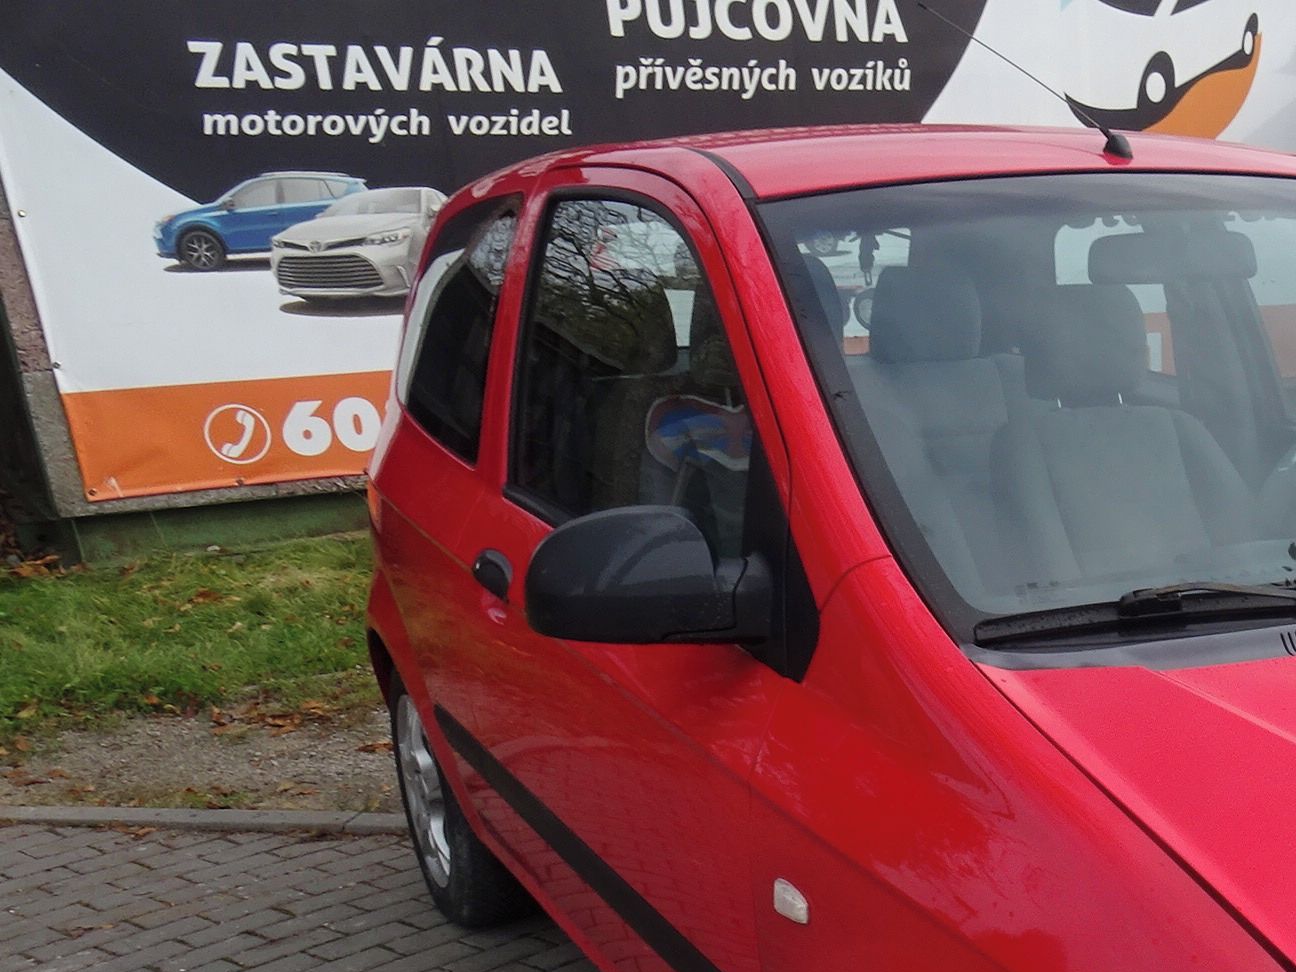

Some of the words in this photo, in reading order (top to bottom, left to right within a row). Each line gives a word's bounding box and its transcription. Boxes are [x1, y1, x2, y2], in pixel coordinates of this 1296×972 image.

[187, 37, 562, 93] ZASTAVÁRNA
[615, 57, 796, 99] přívěsných
[811, 58, 911, 91] vozíků
[203, 108, 430, 143] motorových
[448, 110, 571, 136] vozidel
[282, 396, 393, 457] 60
